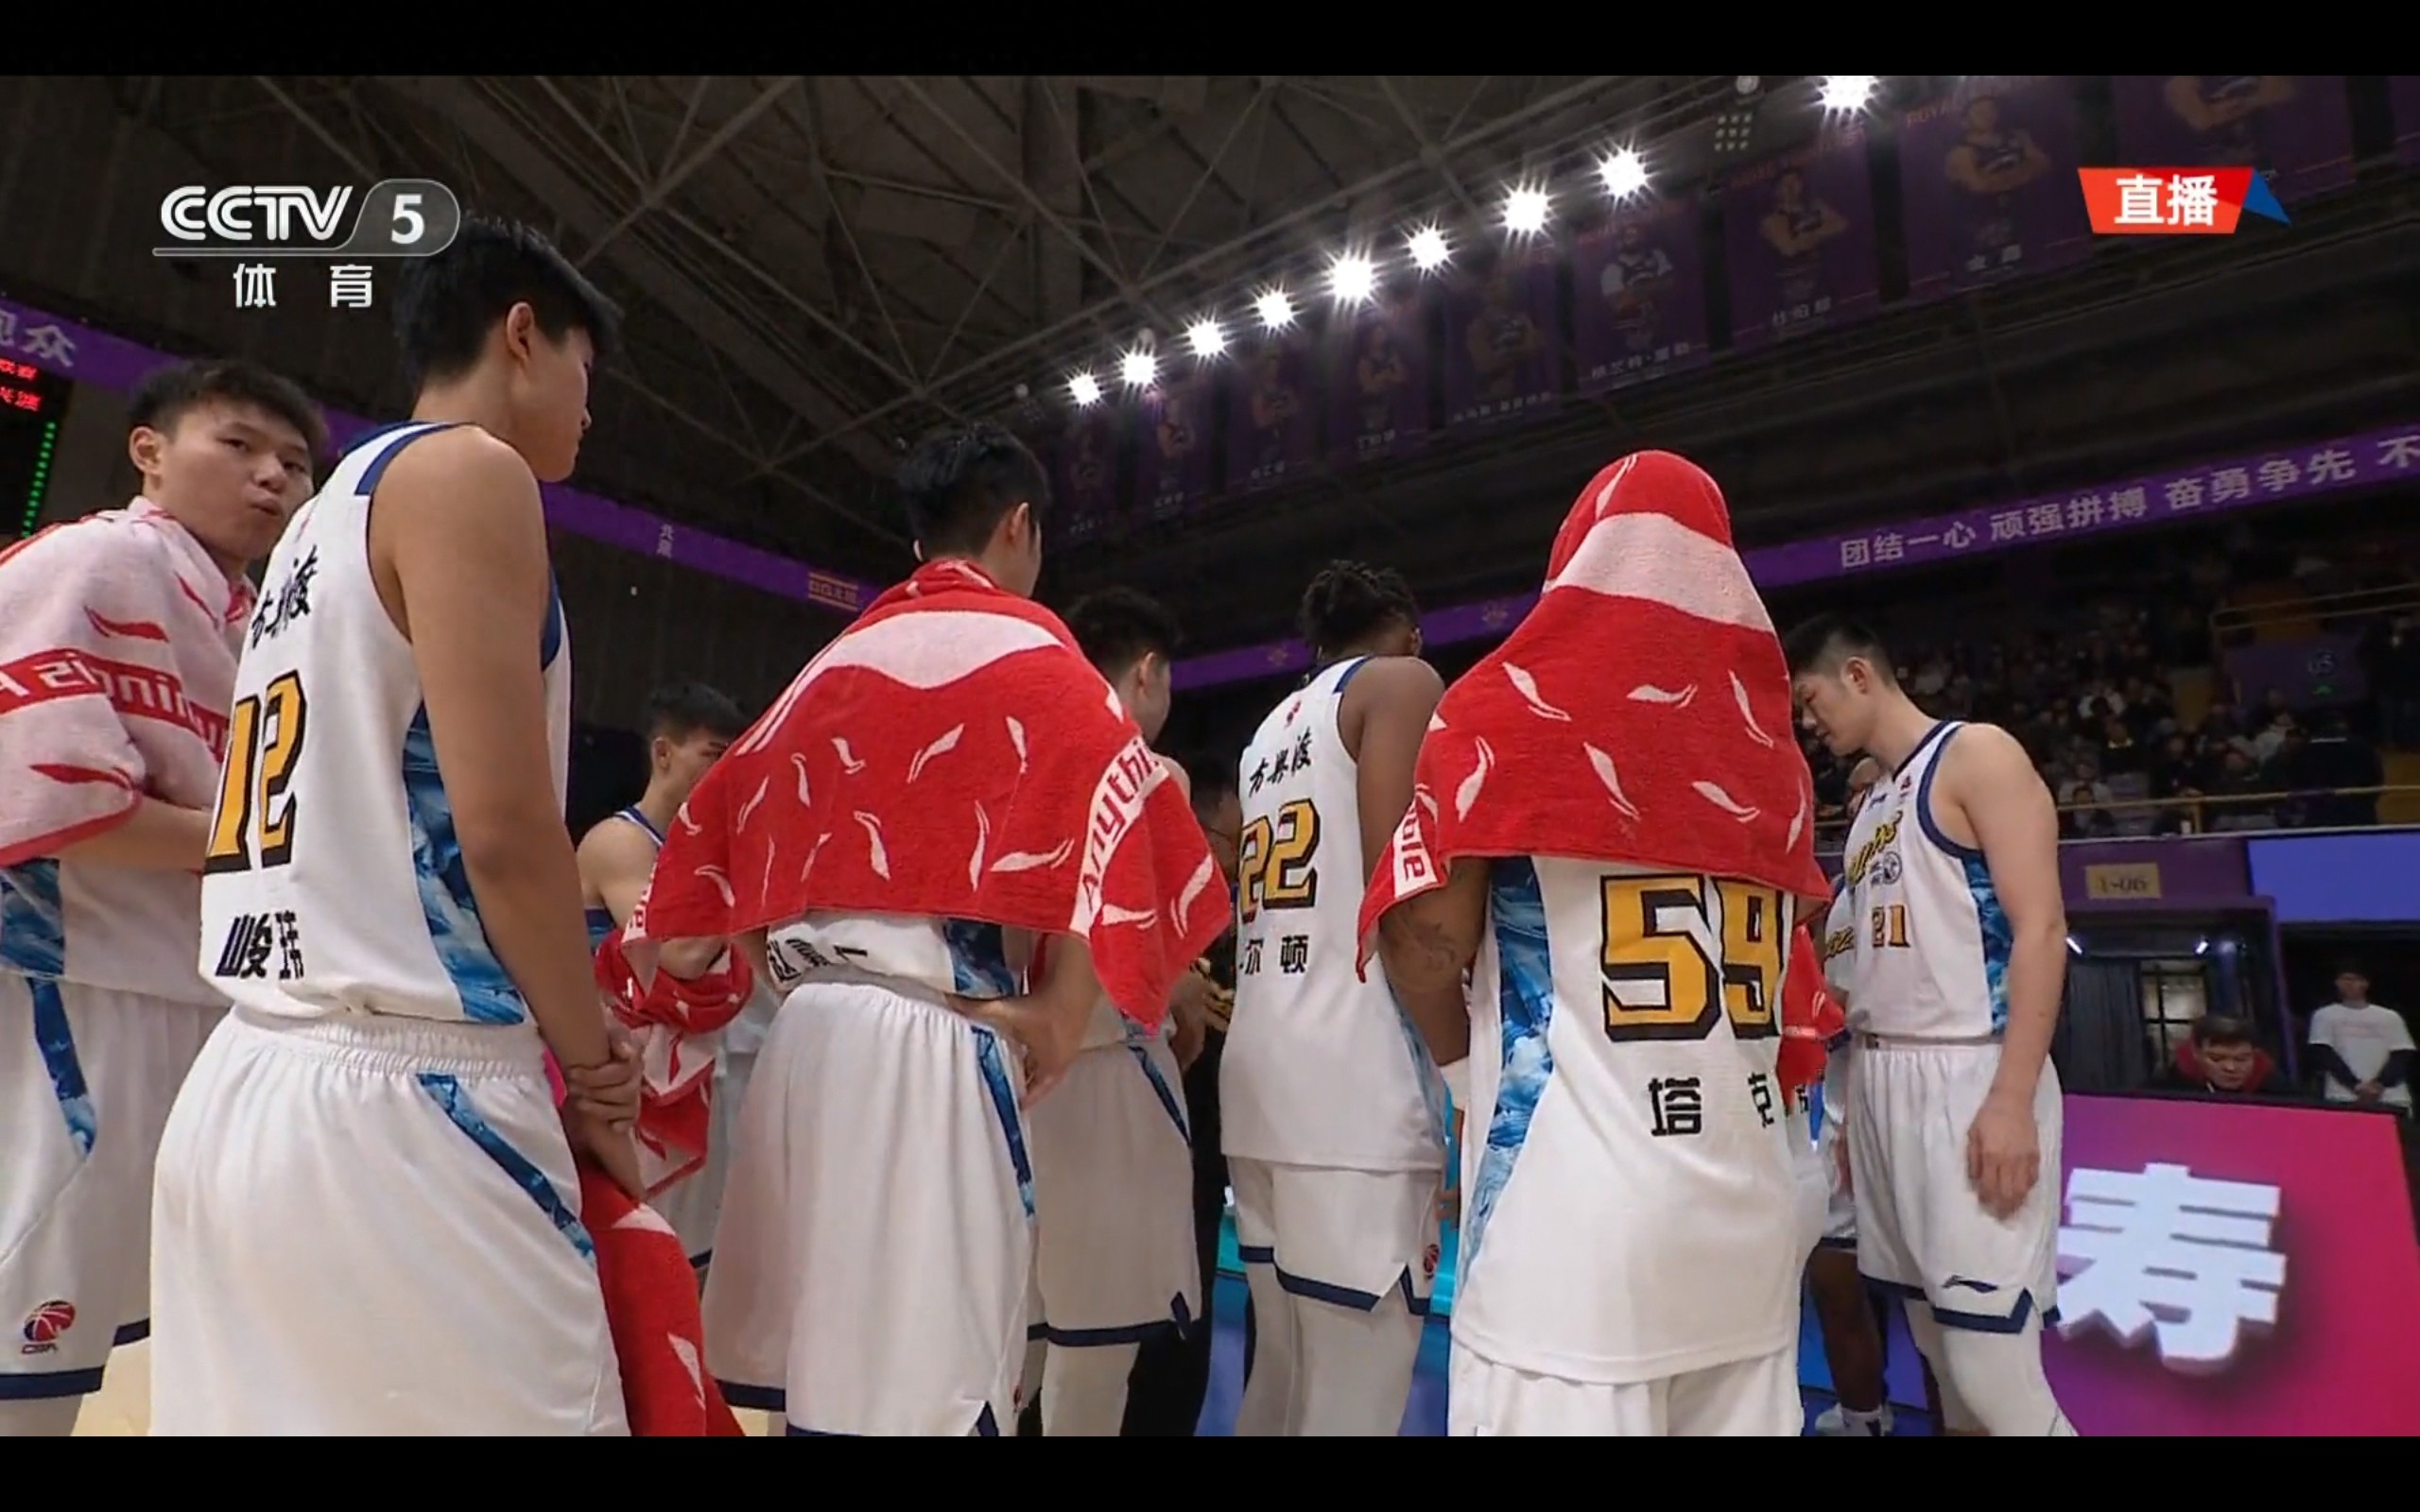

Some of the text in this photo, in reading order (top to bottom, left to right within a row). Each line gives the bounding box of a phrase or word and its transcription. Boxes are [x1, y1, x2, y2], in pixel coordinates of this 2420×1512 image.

[1840, 435, 2420, 568] 团结一心 顽强拼搏 奋勇争先 不
[204, 669, 308, 876] 12
[1082, 739, 1160, 912] Anythi
[1240, 798, 1321, 924] 22
[1872, 904, 1911, 948] 21
[1240, 935, 1309, 975] 尔顿
[1599, 874, 1785, 1042] 59
[2056, 1162, 2288, 1376] 寿
